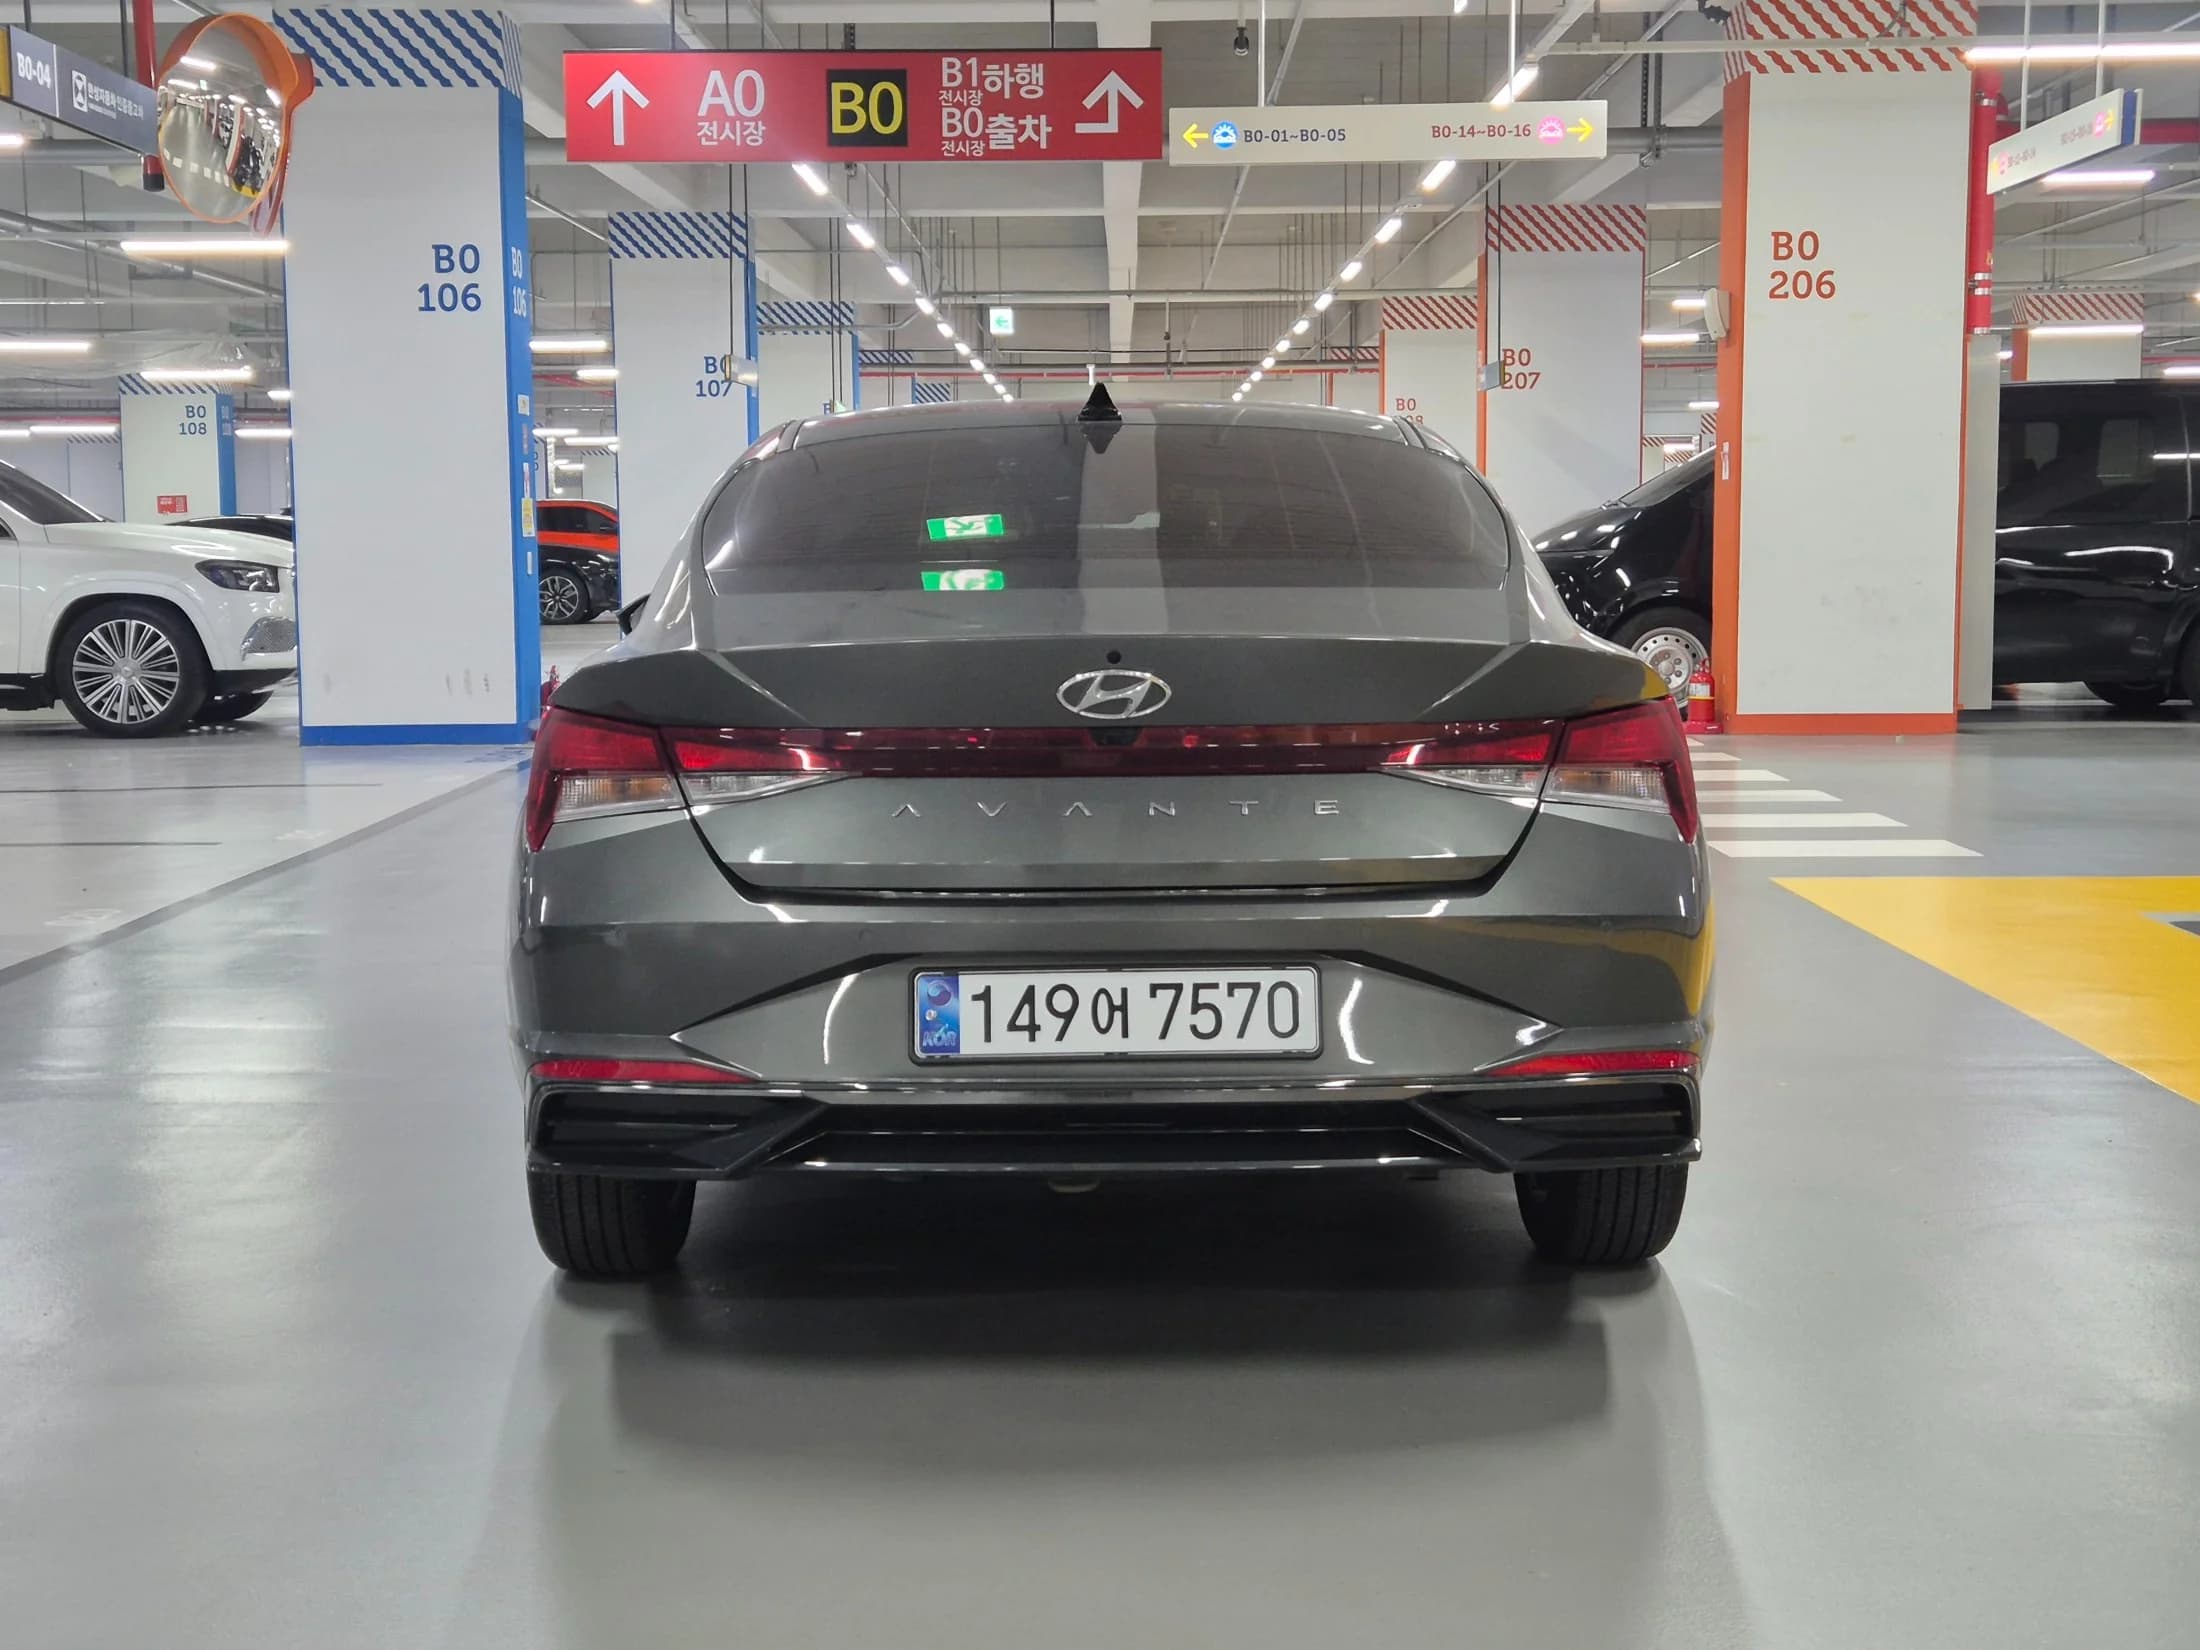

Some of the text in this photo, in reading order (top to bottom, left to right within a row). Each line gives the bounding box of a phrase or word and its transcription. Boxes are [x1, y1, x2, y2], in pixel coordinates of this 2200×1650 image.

[16, 52, 52, 88] B0-04
[942, 57, 1044, 99] B1 하행
[698, 69, 766, 117] A0
[939, 89, 984, 106] 전시장
[831, 81, 903, 134] B0
[697, 121, 766, 146] 전시장
[942, 107, 1053, 150] B0 출차
[1243, 127, 1347, 144] B0-01~B0-05
[1431, 123, 1532, 140] B0-14~B0-16
[941, 140, 985, 157] 전시장
[432, 243, 481, 274] B0
[1770, 231, 1821, 262] B0
[417, 282, 482, 313] 106
[1768, 270, 1837, 301] 206
[512, 286, 527, 318] 106
[1502, 347, 1532, 367] B0
[695, 379, 734, 397] 107
[1501, 372, 1542, 390] 207
[185, 404, 207, 419] B0
[178, 422, 208, 435] 108
[891, 799, 1340, 818] AVANTE
